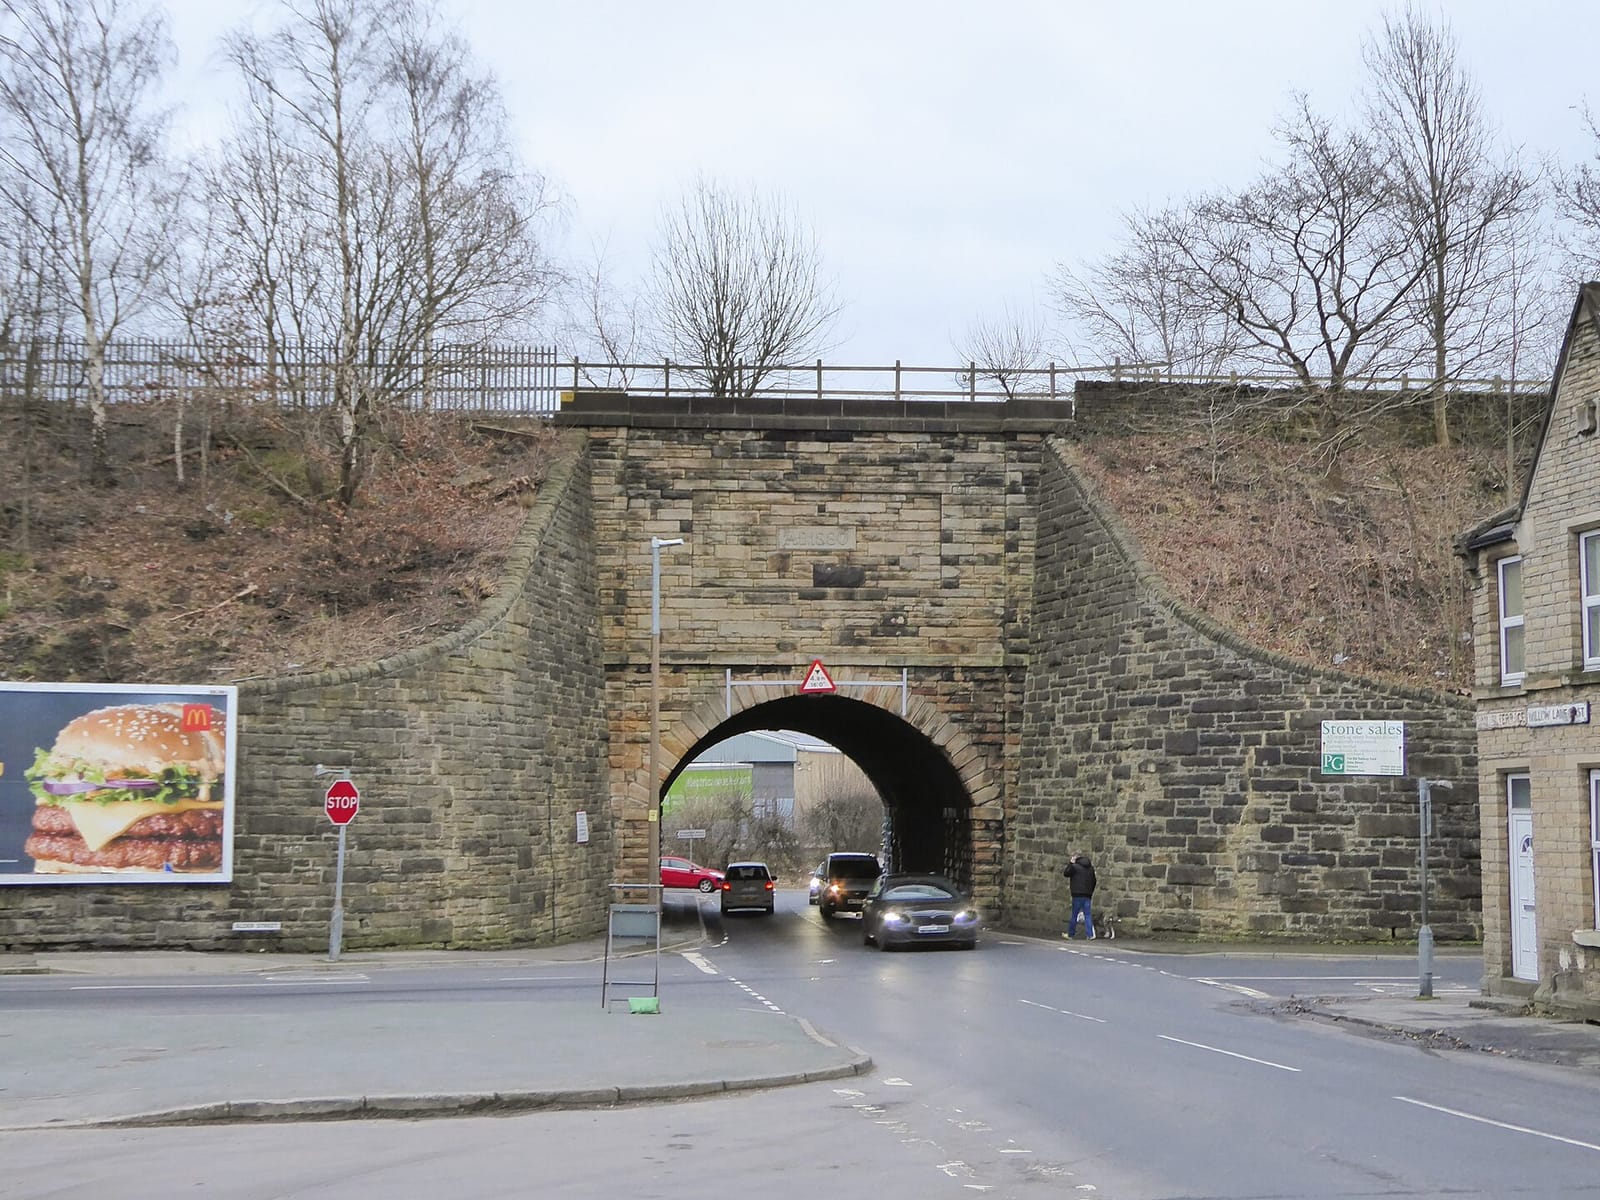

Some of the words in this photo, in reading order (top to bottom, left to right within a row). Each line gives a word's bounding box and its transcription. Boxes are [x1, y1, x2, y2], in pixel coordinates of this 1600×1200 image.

[1322, 722, 1363, 735] Stone
[1368, 721, 1402, 735] sales
[1324, 754, 1344, 771] PG
[327, 796, 357, 809] STOP
